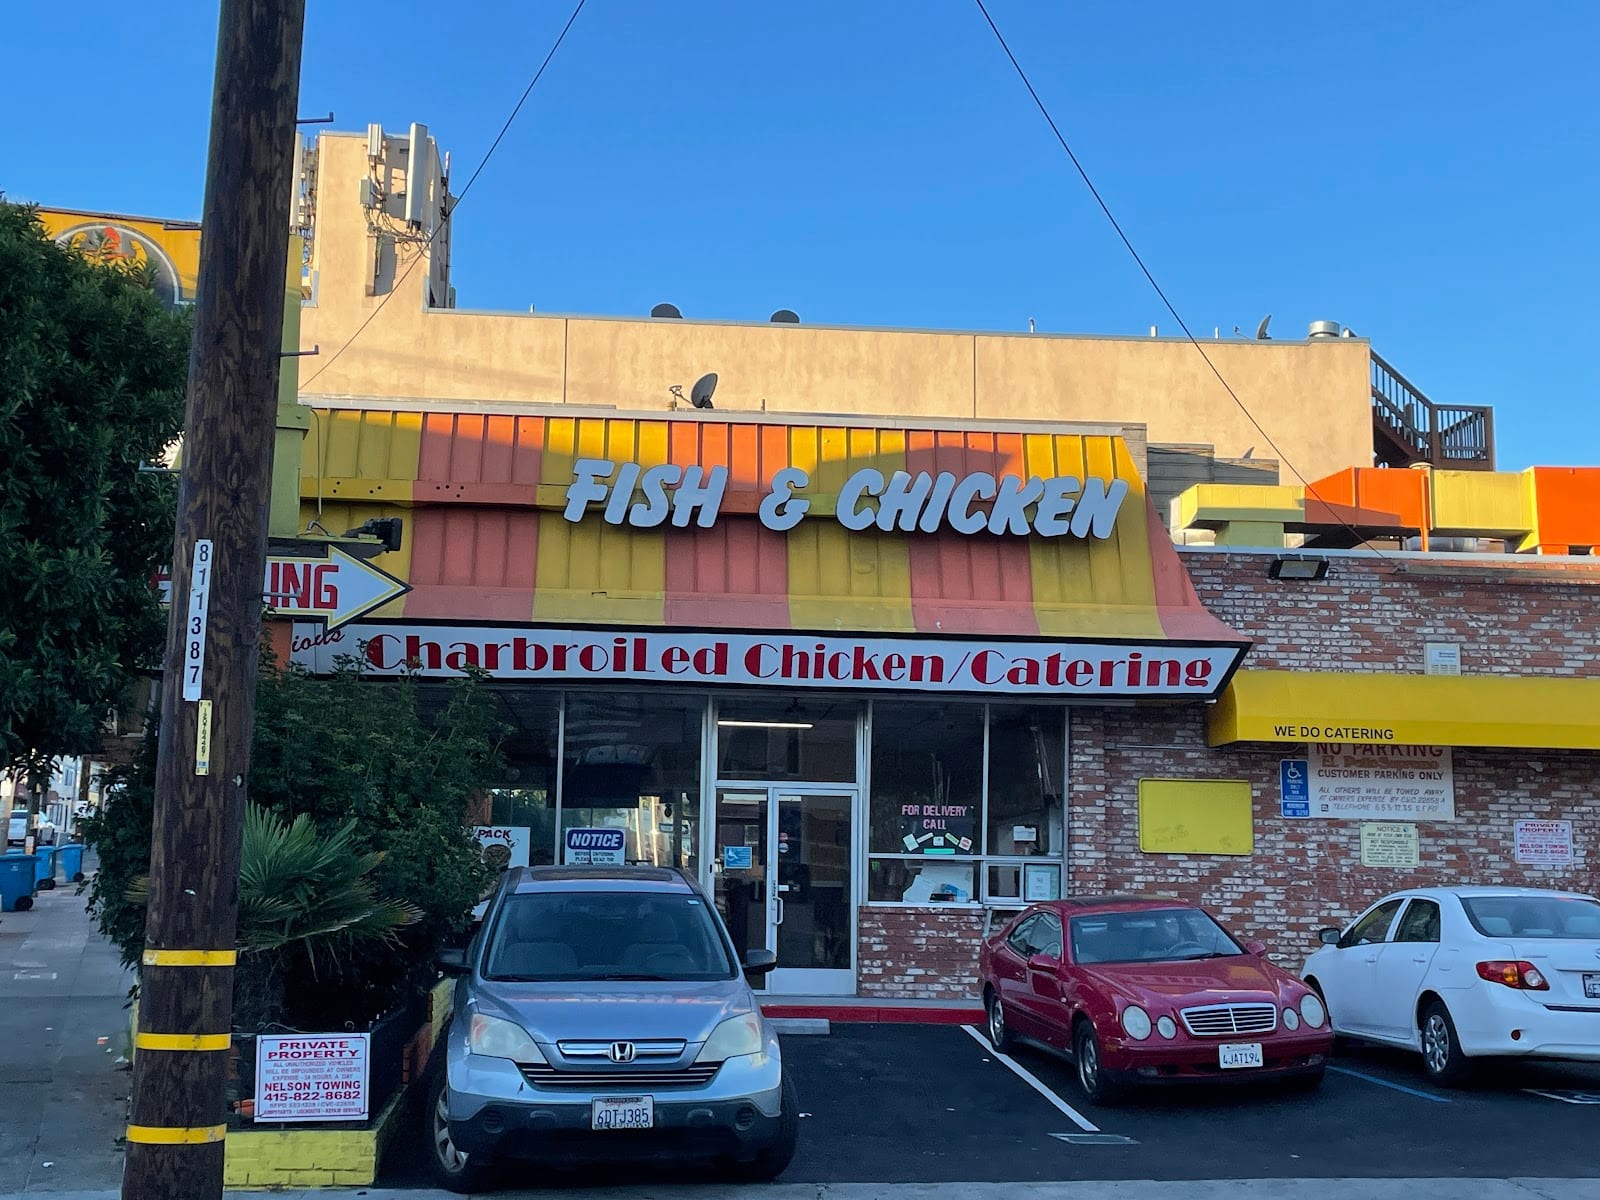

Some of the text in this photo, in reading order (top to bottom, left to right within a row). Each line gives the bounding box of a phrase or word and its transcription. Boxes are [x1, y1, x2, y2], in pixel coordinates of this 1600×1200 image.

[563, 458, 1129, 539] FISH & CHICKEN
[270, 562, 339, 609] ING
[744, 643, 1212, 688] Chicken/Catering
[1274, 726, 1394, 740] WE DO CATERING
[1317, 743, 1444, 757] NO PARKING
[1317, 769, 1444, 781] CUSTOMER PARKING ONLY
[901, 804, 968, 817] FOR DELIVERY
[923, 818, 947, 830] CALL
[1376, 825, 1401, 833] NOTICE
[477, 829, 512, 839] PACK
[570, 833, 621, 847] NOTICE
[279, 1040, 349, 1050] PRIVATE
[268, 1049, 360, 1060] PROPERTY
[264, 1080, 361, 1092] NELSON TOWING
[264, 1090, 361, 1101] 415-822-8682
